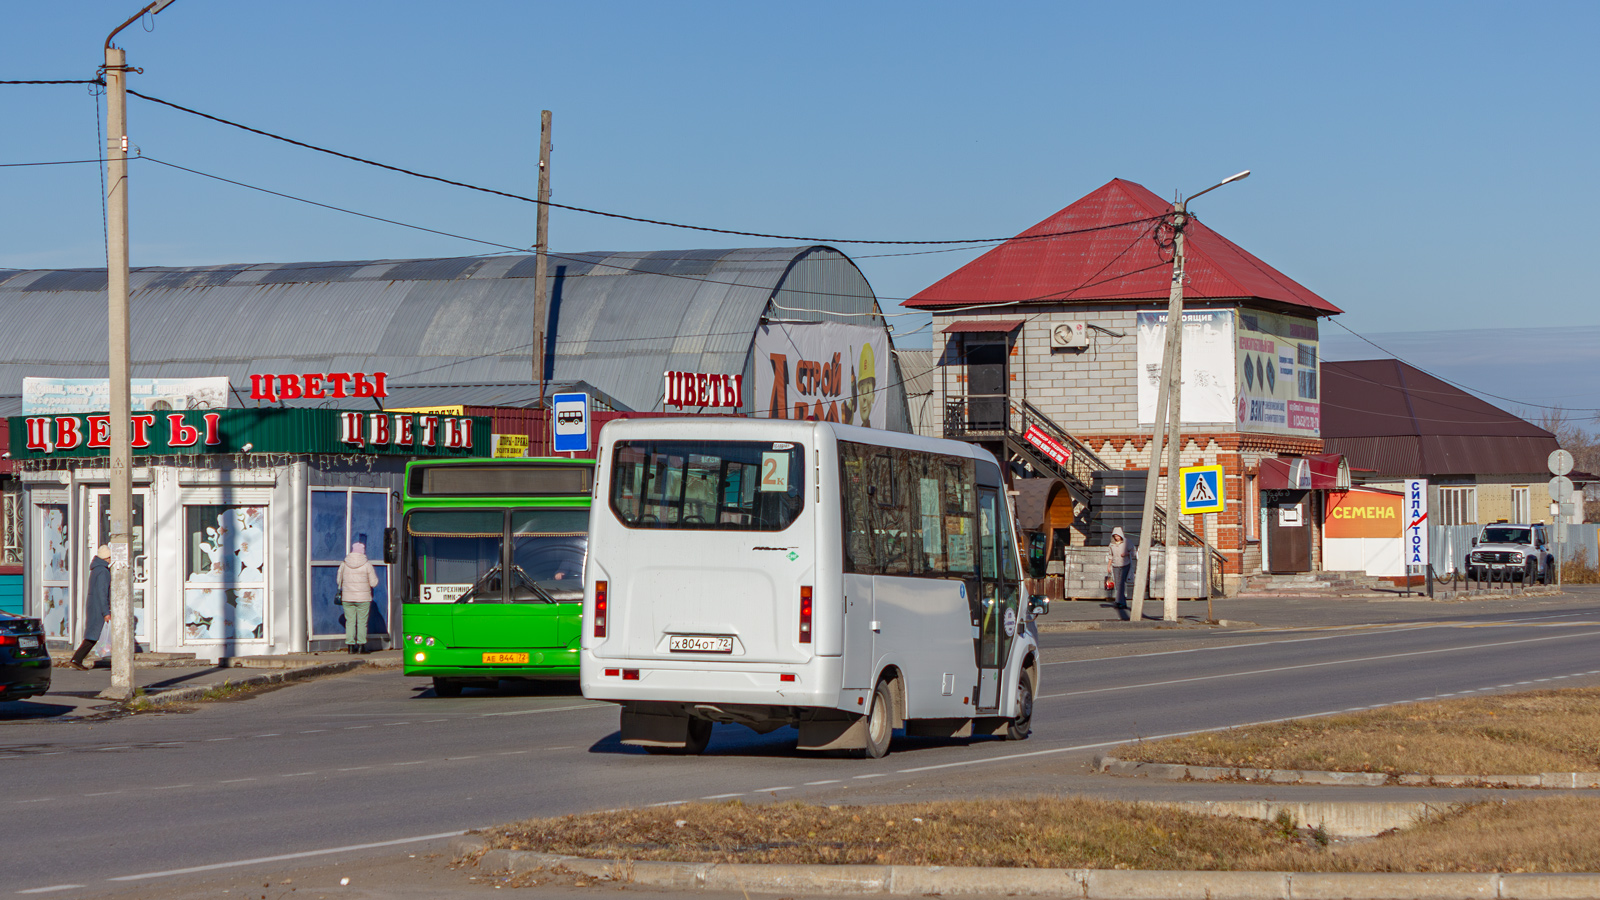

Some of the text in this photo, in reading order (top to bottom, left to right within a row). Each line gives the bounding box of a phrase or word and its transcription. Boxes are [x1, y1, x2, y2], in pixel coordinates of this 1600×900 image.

[1159, 314, 1213, 322] НАОЯЩИЕ
[249, 372, 389, 403] ЦВЕТЫ
[663, 370, 743, 411] ЦВЕТЫ
[795, 352, 842, 397] СТРОЙ
[25, 413, 221, 453] ЦВЕТЫ
[341, 412, 473, 448] ЦВЕТЫ
[1332, 506, 1396, 519] СЕМЕНА
[1411, 482, 1420, 518] СИЛА
[1412, 526, 1421, 563] ТОКА
[423, 586, 432, 601] 5
